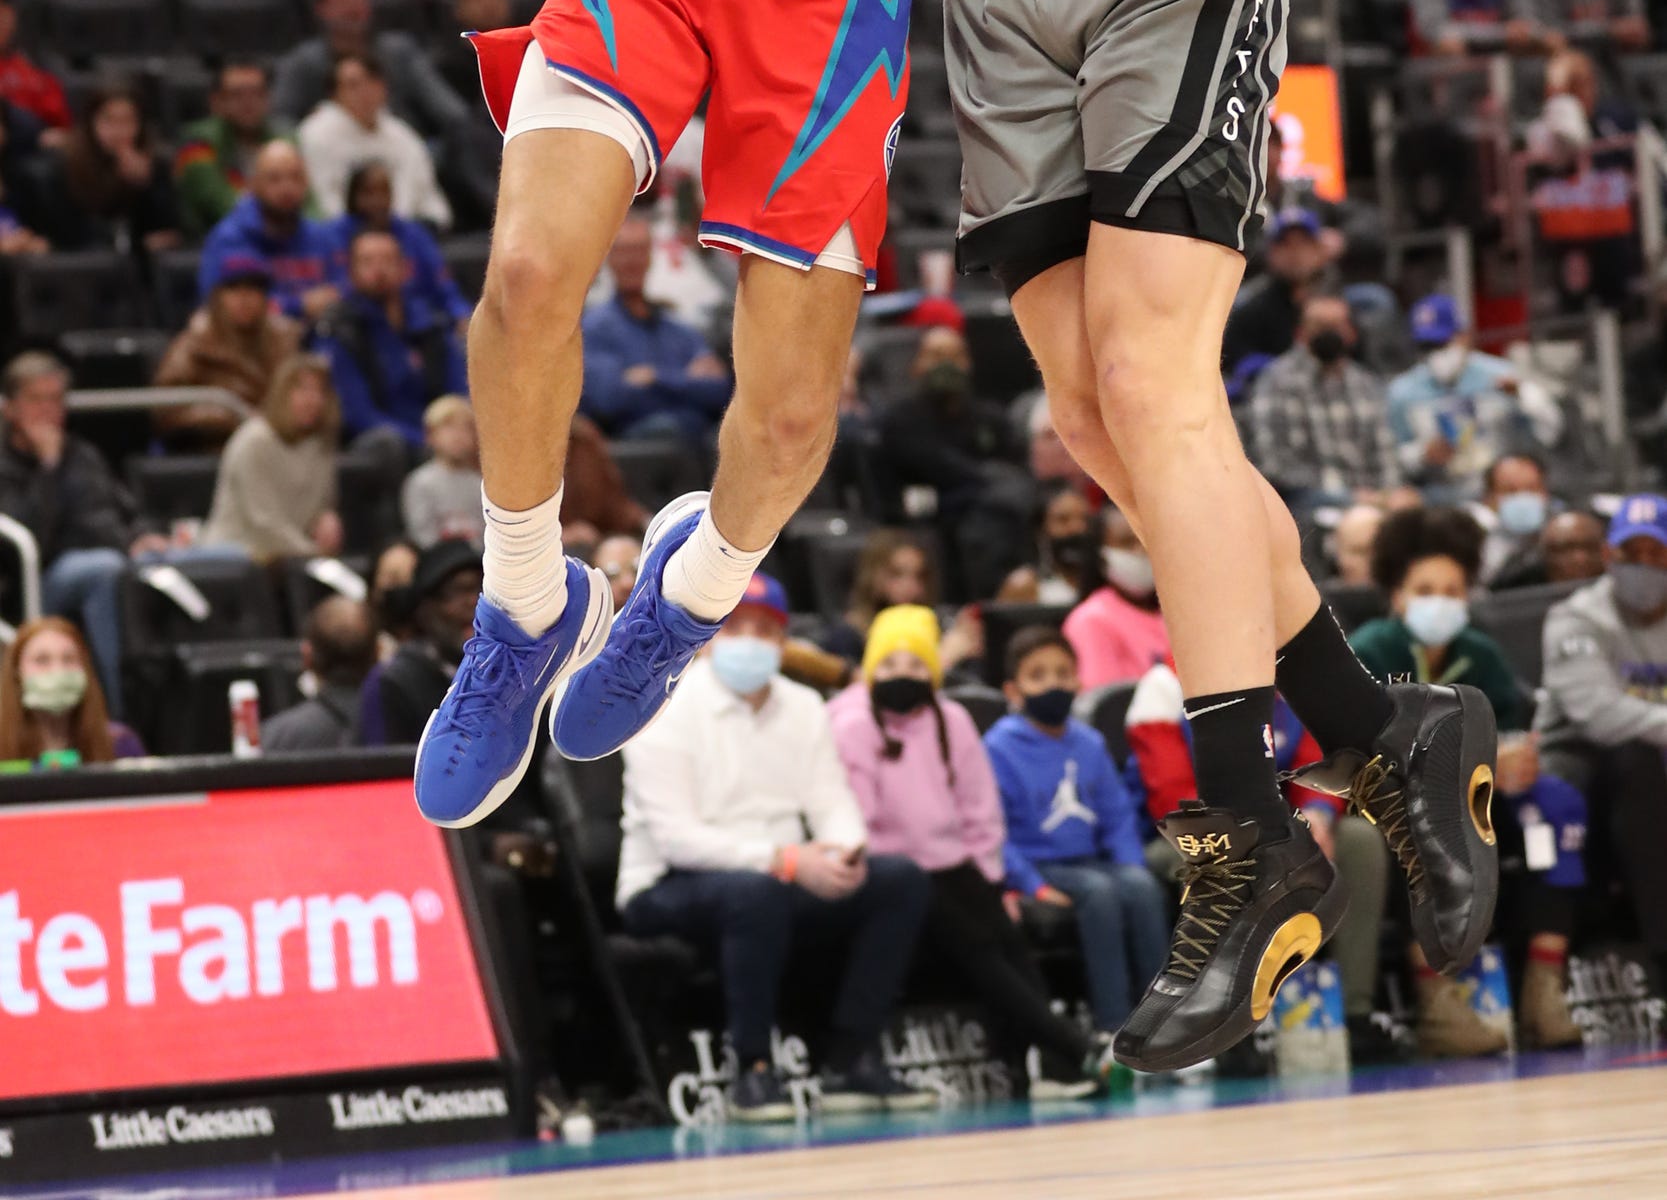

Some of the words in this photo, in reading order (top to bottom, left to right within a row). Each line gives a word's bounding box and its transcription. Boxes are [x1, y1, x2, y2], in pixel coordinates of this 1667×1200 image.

[688, 1024, 811, 1079] Lile
[88, 1108, 168, 1150] Little
[165, 1104, 275, 1144] Caesars
[328, 1088, 404, 1130] Little
[402, 1085, 509, 1123] Caesars
